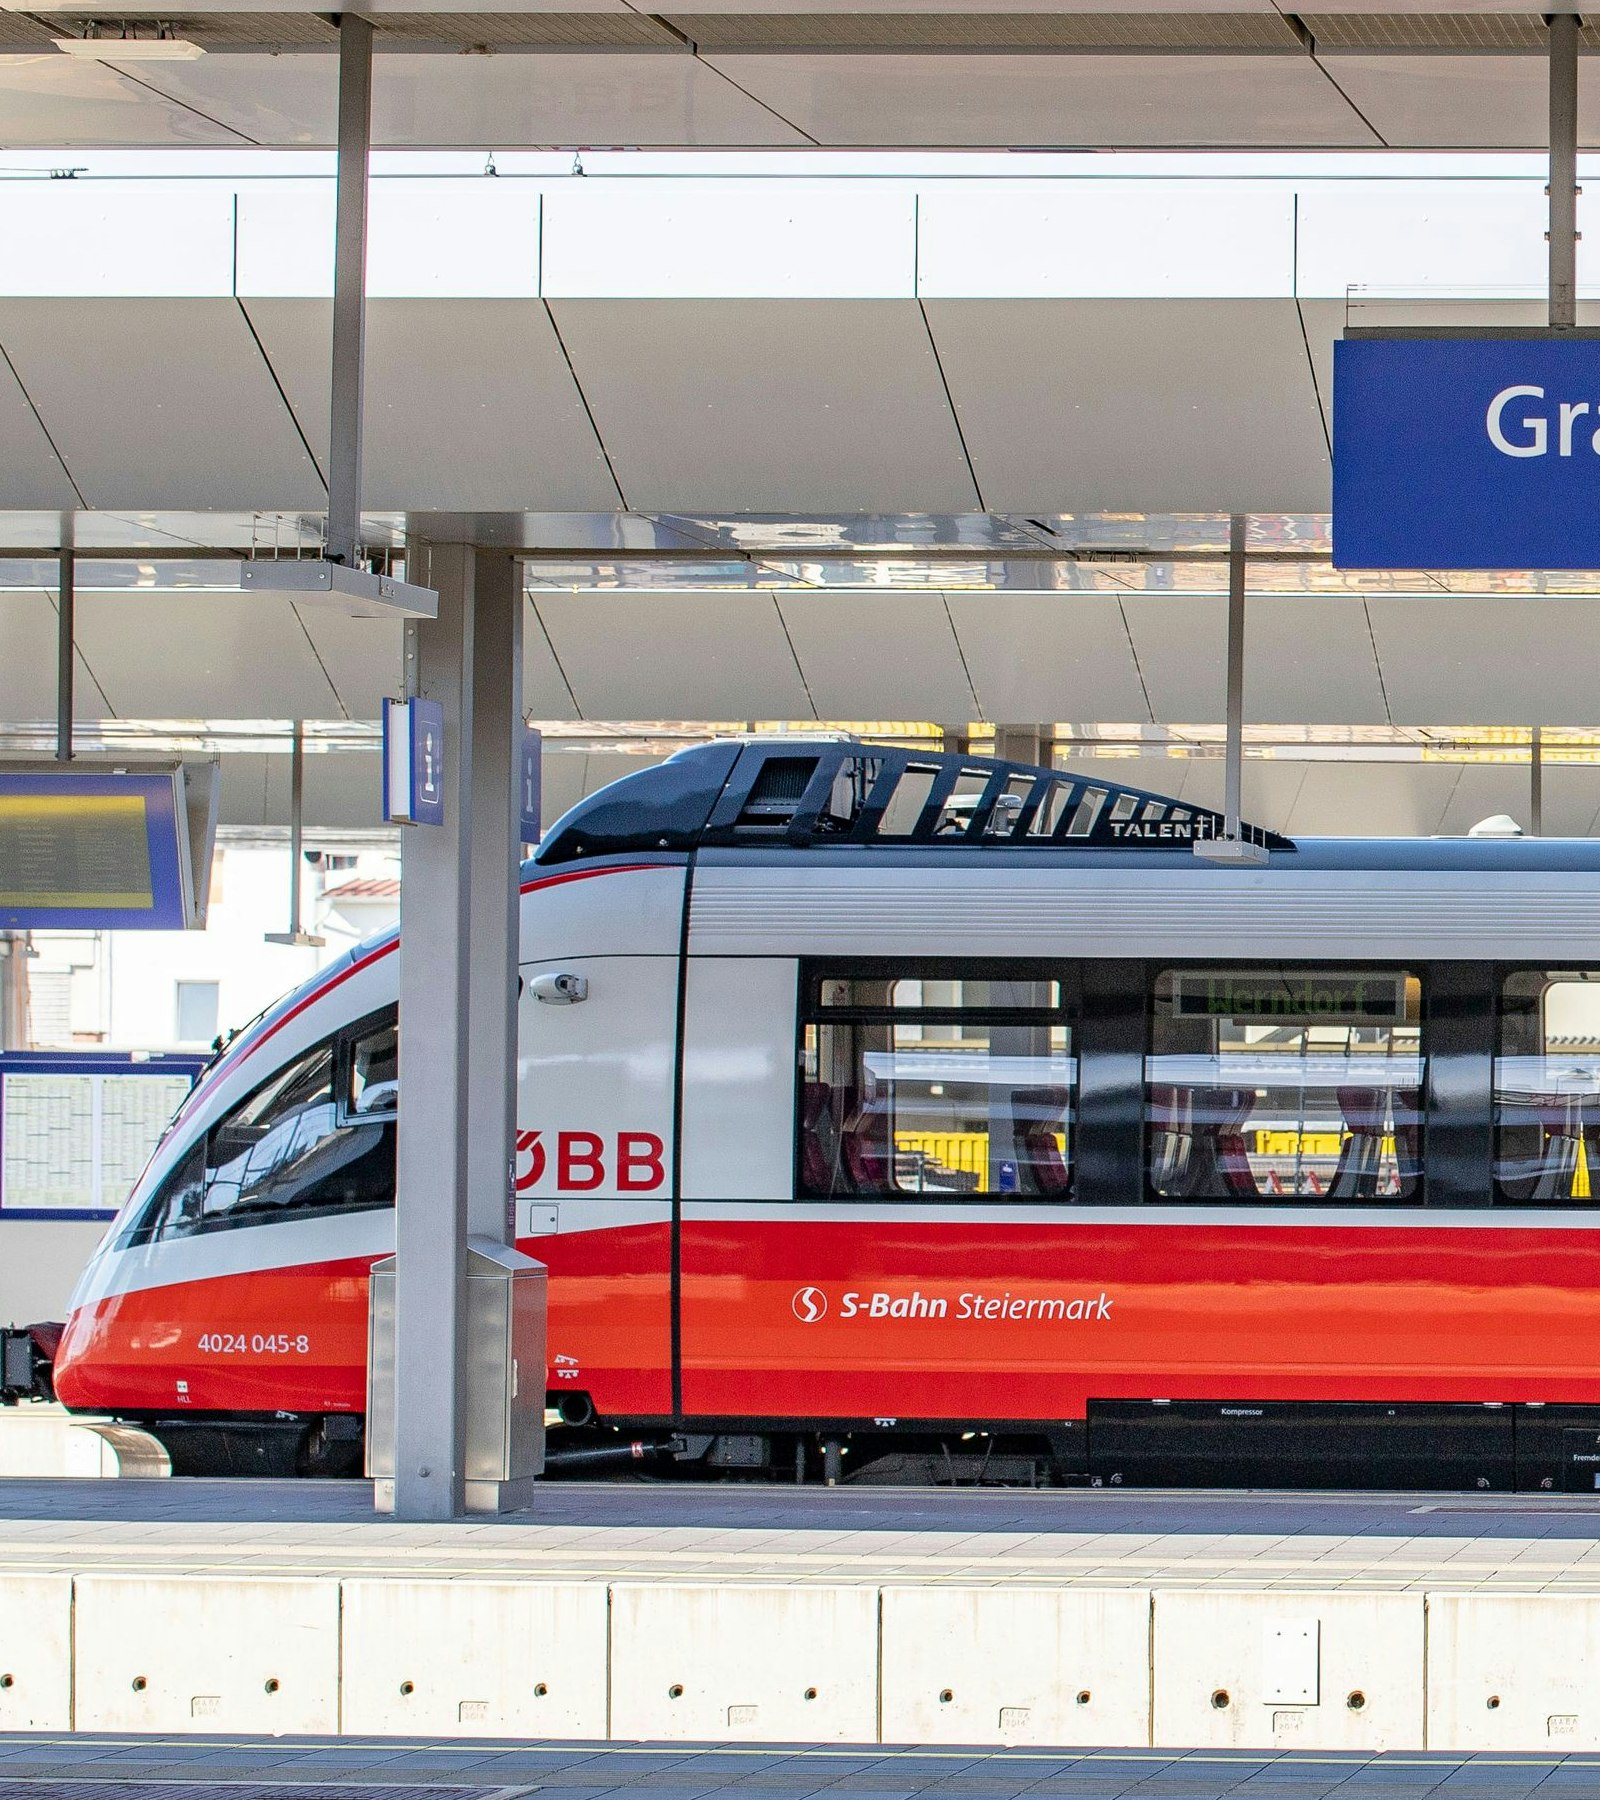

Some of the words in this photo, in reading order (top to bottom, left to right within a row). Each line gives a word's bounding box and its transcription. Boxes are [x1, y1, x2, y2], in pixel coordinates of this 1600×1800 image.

[1110, 823, 1208, 838] TALENT
[1207, 979, 1367, 1015] Werndorf
[840, 1292, 947, 1318] S-Bahn
[955, 1292, 1114, 1320] Steiermark
[197, 1333, 247, 1353] 4024
[251, 1334, 309, 1354] 045-8
[1221, 1408, 1264, 1417] Kompressor
